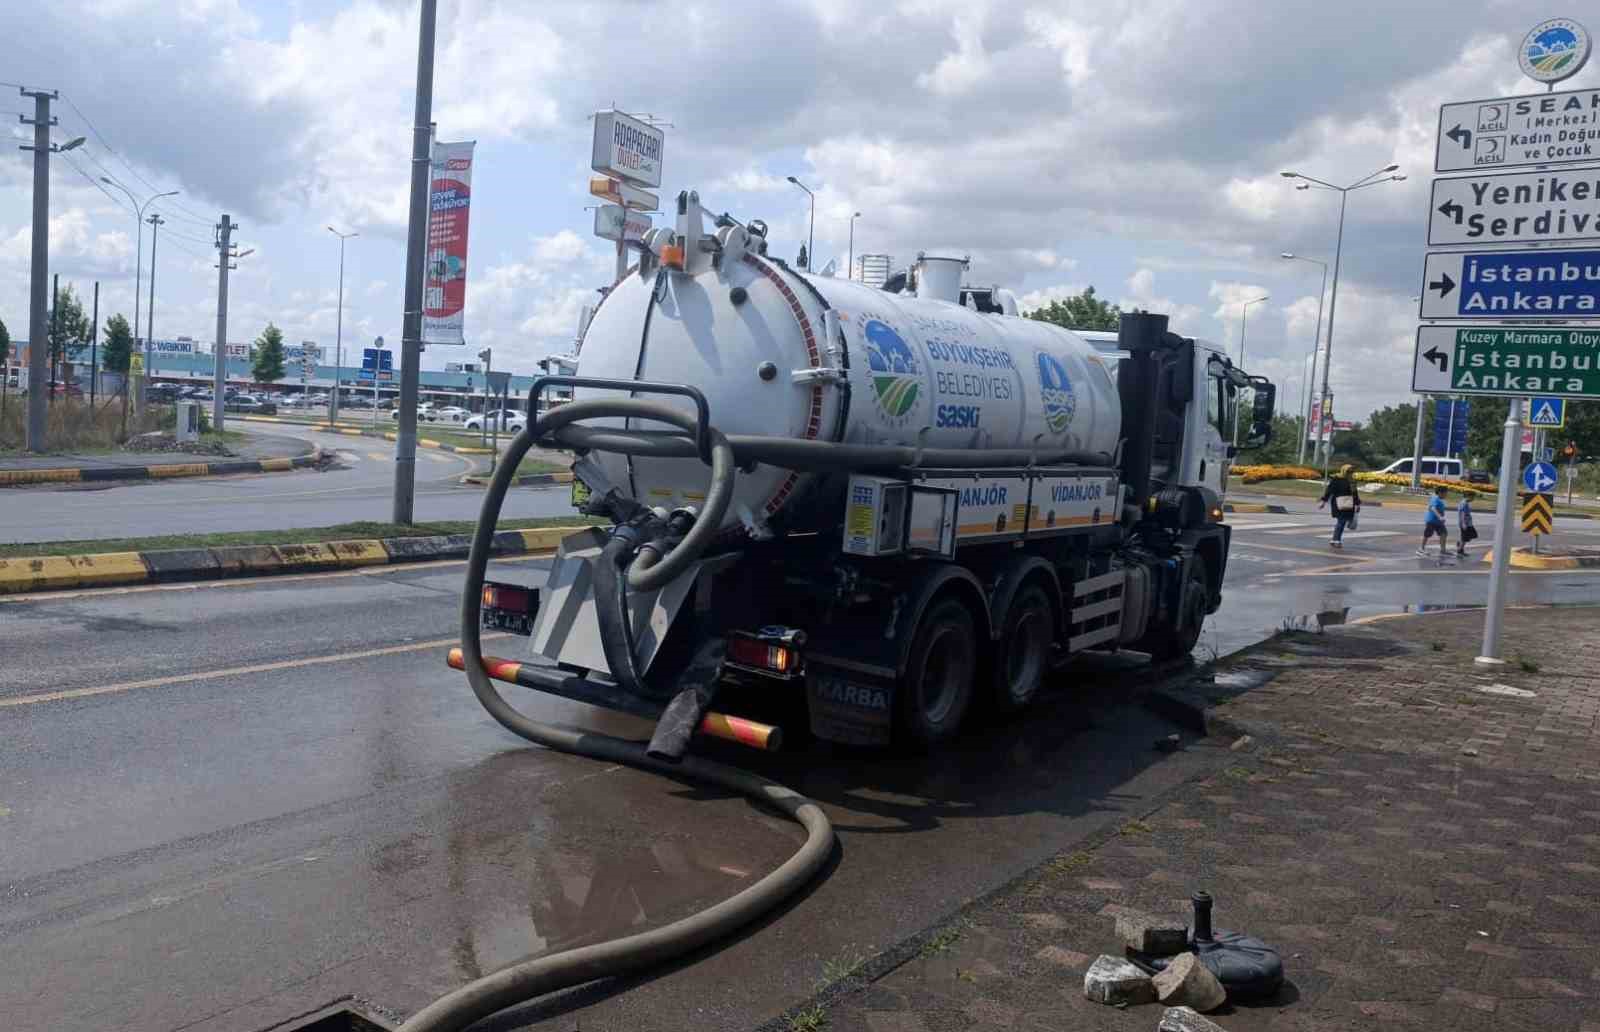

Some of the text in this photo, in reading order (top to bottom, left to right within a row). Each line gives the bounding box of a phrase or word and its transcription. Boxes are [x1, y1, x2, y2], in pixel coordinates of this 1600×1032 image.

[1510, 128, 1600, 146] Kadın Doğu
[1524, 143, 1592, 159] ve Çocuk
[1471, 178, 1600, 206] Yenike
[1464, 291, 1595, 311] Ankara
[1460, 330, 1600, 348] Kuzey Marmara Otoy
[1456, 370, 1584, 392] Ankara
[959, 483, 1007, 507] ANJÖR
